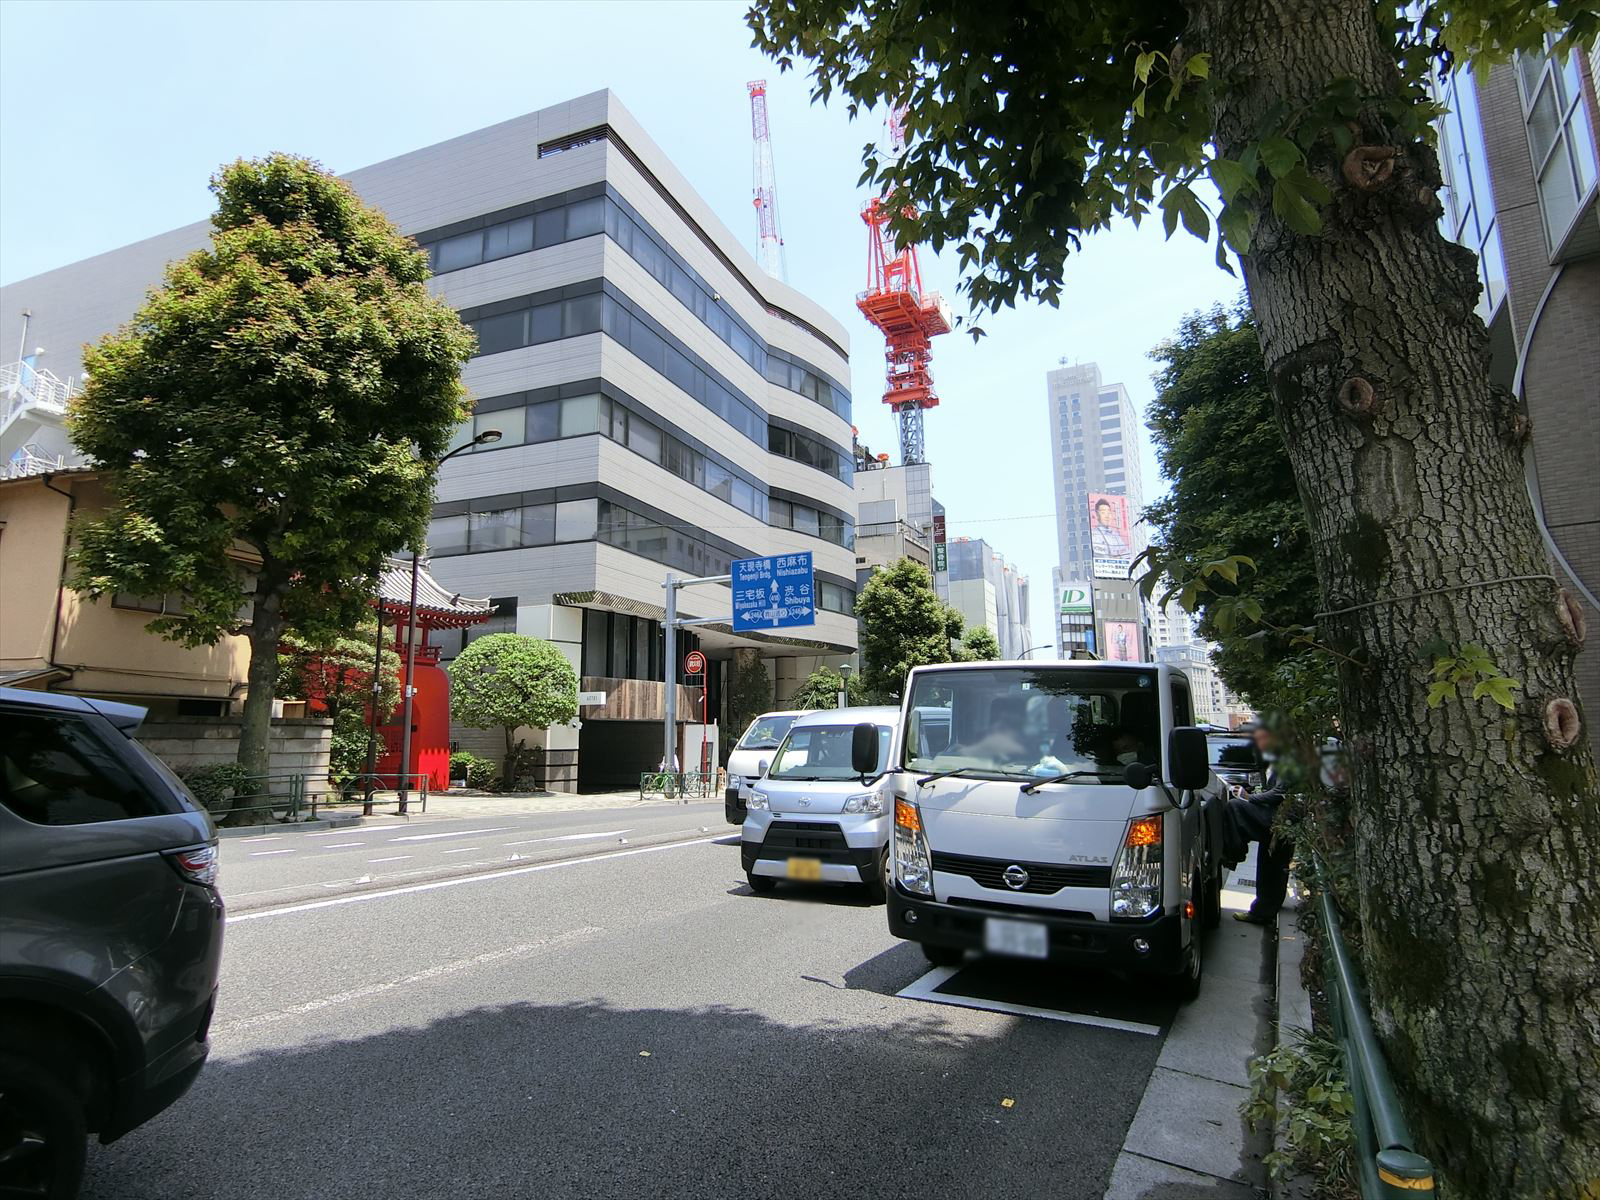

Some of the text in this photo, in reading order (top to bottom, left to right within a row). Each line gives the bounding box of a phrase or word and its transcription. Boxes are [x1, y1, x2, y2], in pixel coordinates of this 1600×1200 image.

[739, 560, 771, 572] 天現寺橋
[777, 555, 807, 568] 西麻布
[777, 567, 808, 576] Nishiazabu
[736, 588, 765, 601] 三宅坂
[785, 584, 810, 596] 渋谷
[785, 597, 810, 605] Shibuya
[1069, 855, 1108, 863] ATLAS
